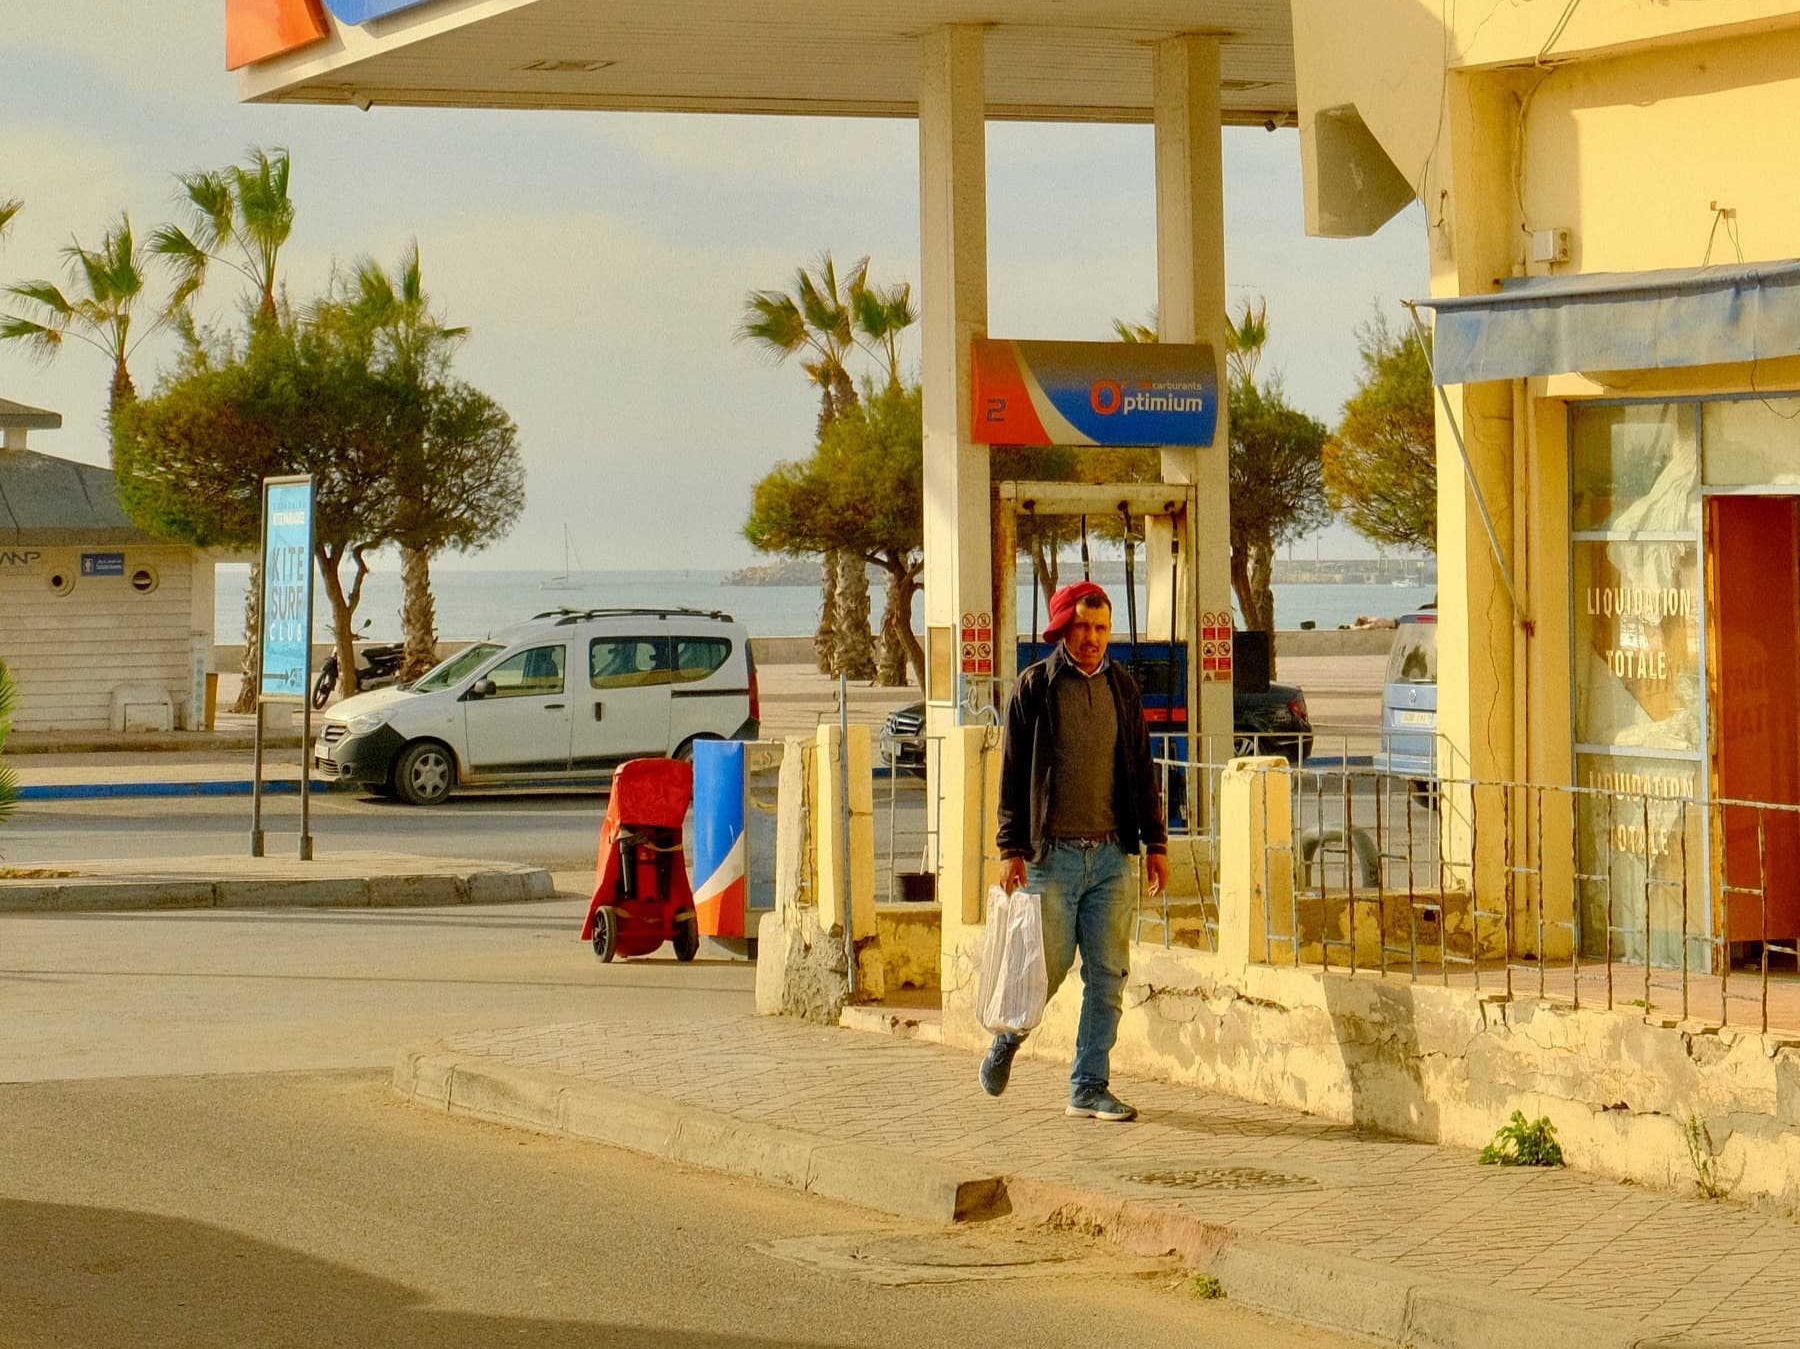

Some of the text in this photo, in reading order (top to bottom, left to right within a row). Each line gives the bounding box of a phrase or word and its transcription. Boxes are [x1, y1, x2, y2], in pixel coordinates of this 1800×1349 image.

[1152, 381, 1202, 390] carburants
[986, 398, 1006, 421] 2
[272, 546, 304, 581] KITE
[271, 586, 303, 619] SURF
[1587, 587, 1691, 619] LIQUIDATION
[270, 622, 302, 641] CLUB
[1606, 650, 1667, 680] TOTALE
